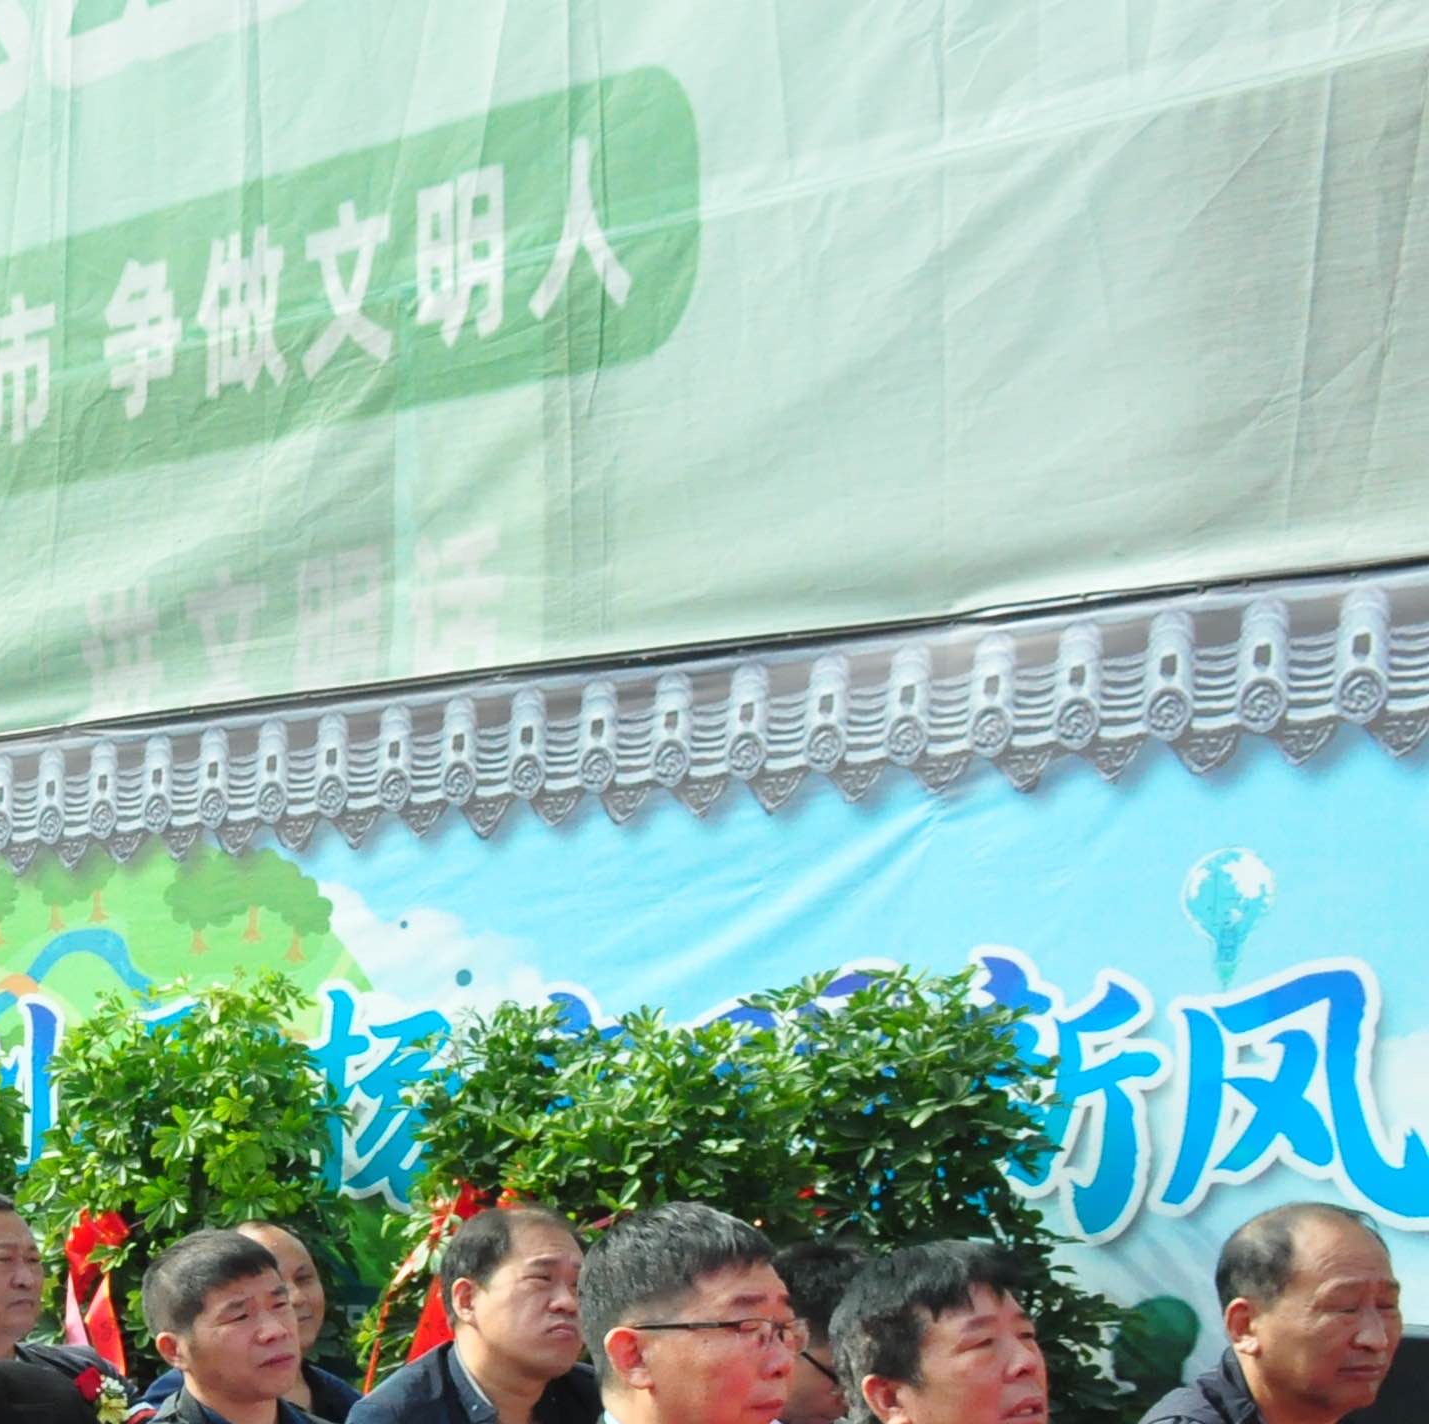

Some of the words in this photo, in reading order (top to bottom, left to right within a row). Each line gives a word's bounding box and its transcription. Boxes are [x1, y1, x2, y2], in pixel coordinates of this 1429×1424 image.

[102, 135, 632, 420] 争做文明人
